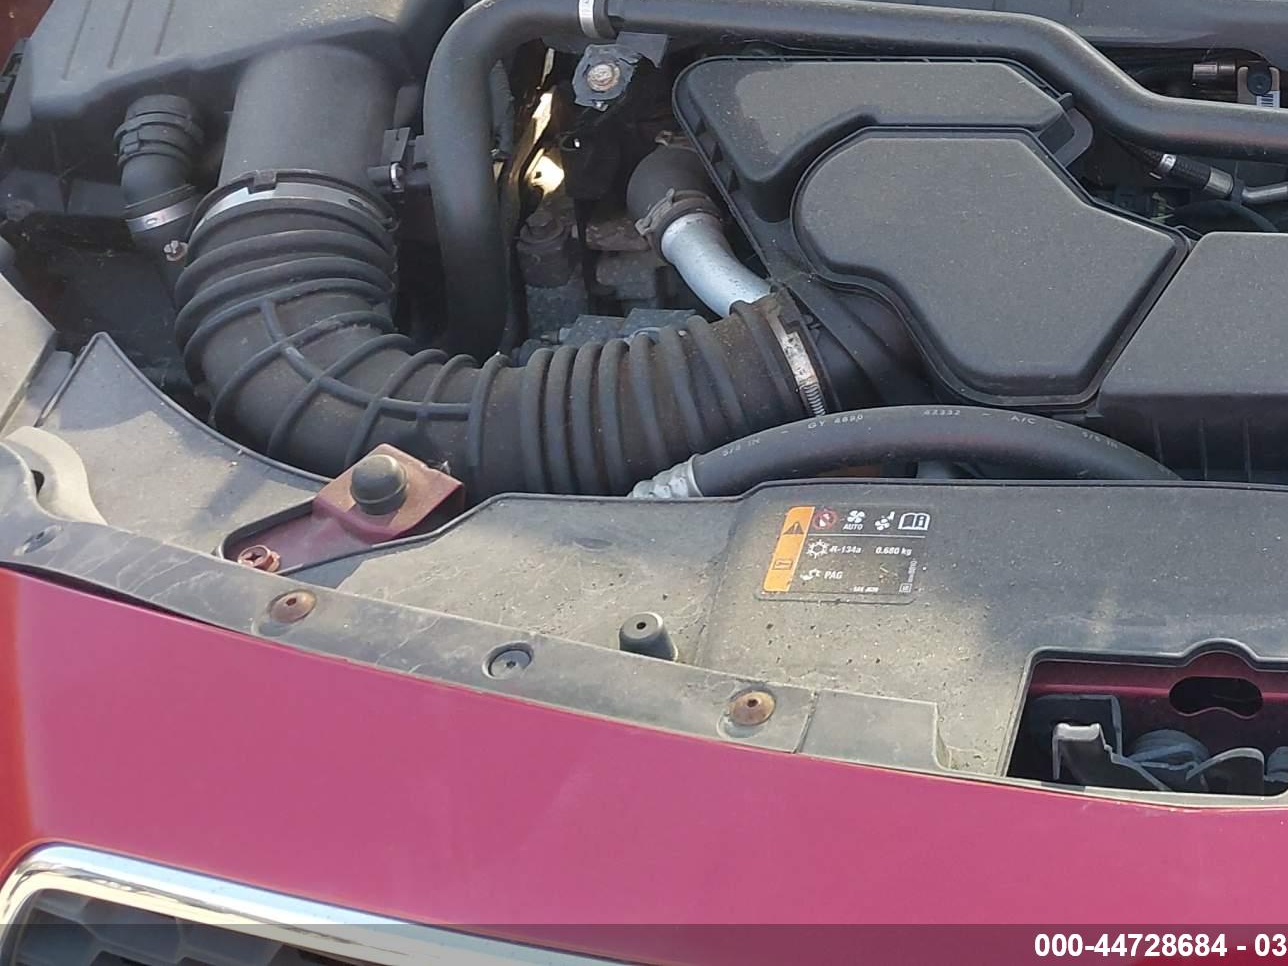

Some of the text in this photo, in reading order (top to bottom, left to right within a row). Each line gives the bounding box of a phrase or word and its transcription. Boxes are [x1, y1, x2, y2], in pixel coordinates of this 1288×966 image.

[1010, 415, 1036, 425] A/C
[842, 523, 865, 531] AUTO
[829, 545, 862, 554] R-134a
[901, 547, 912, 556] kg
[823, 570, 844, 580] PAG
